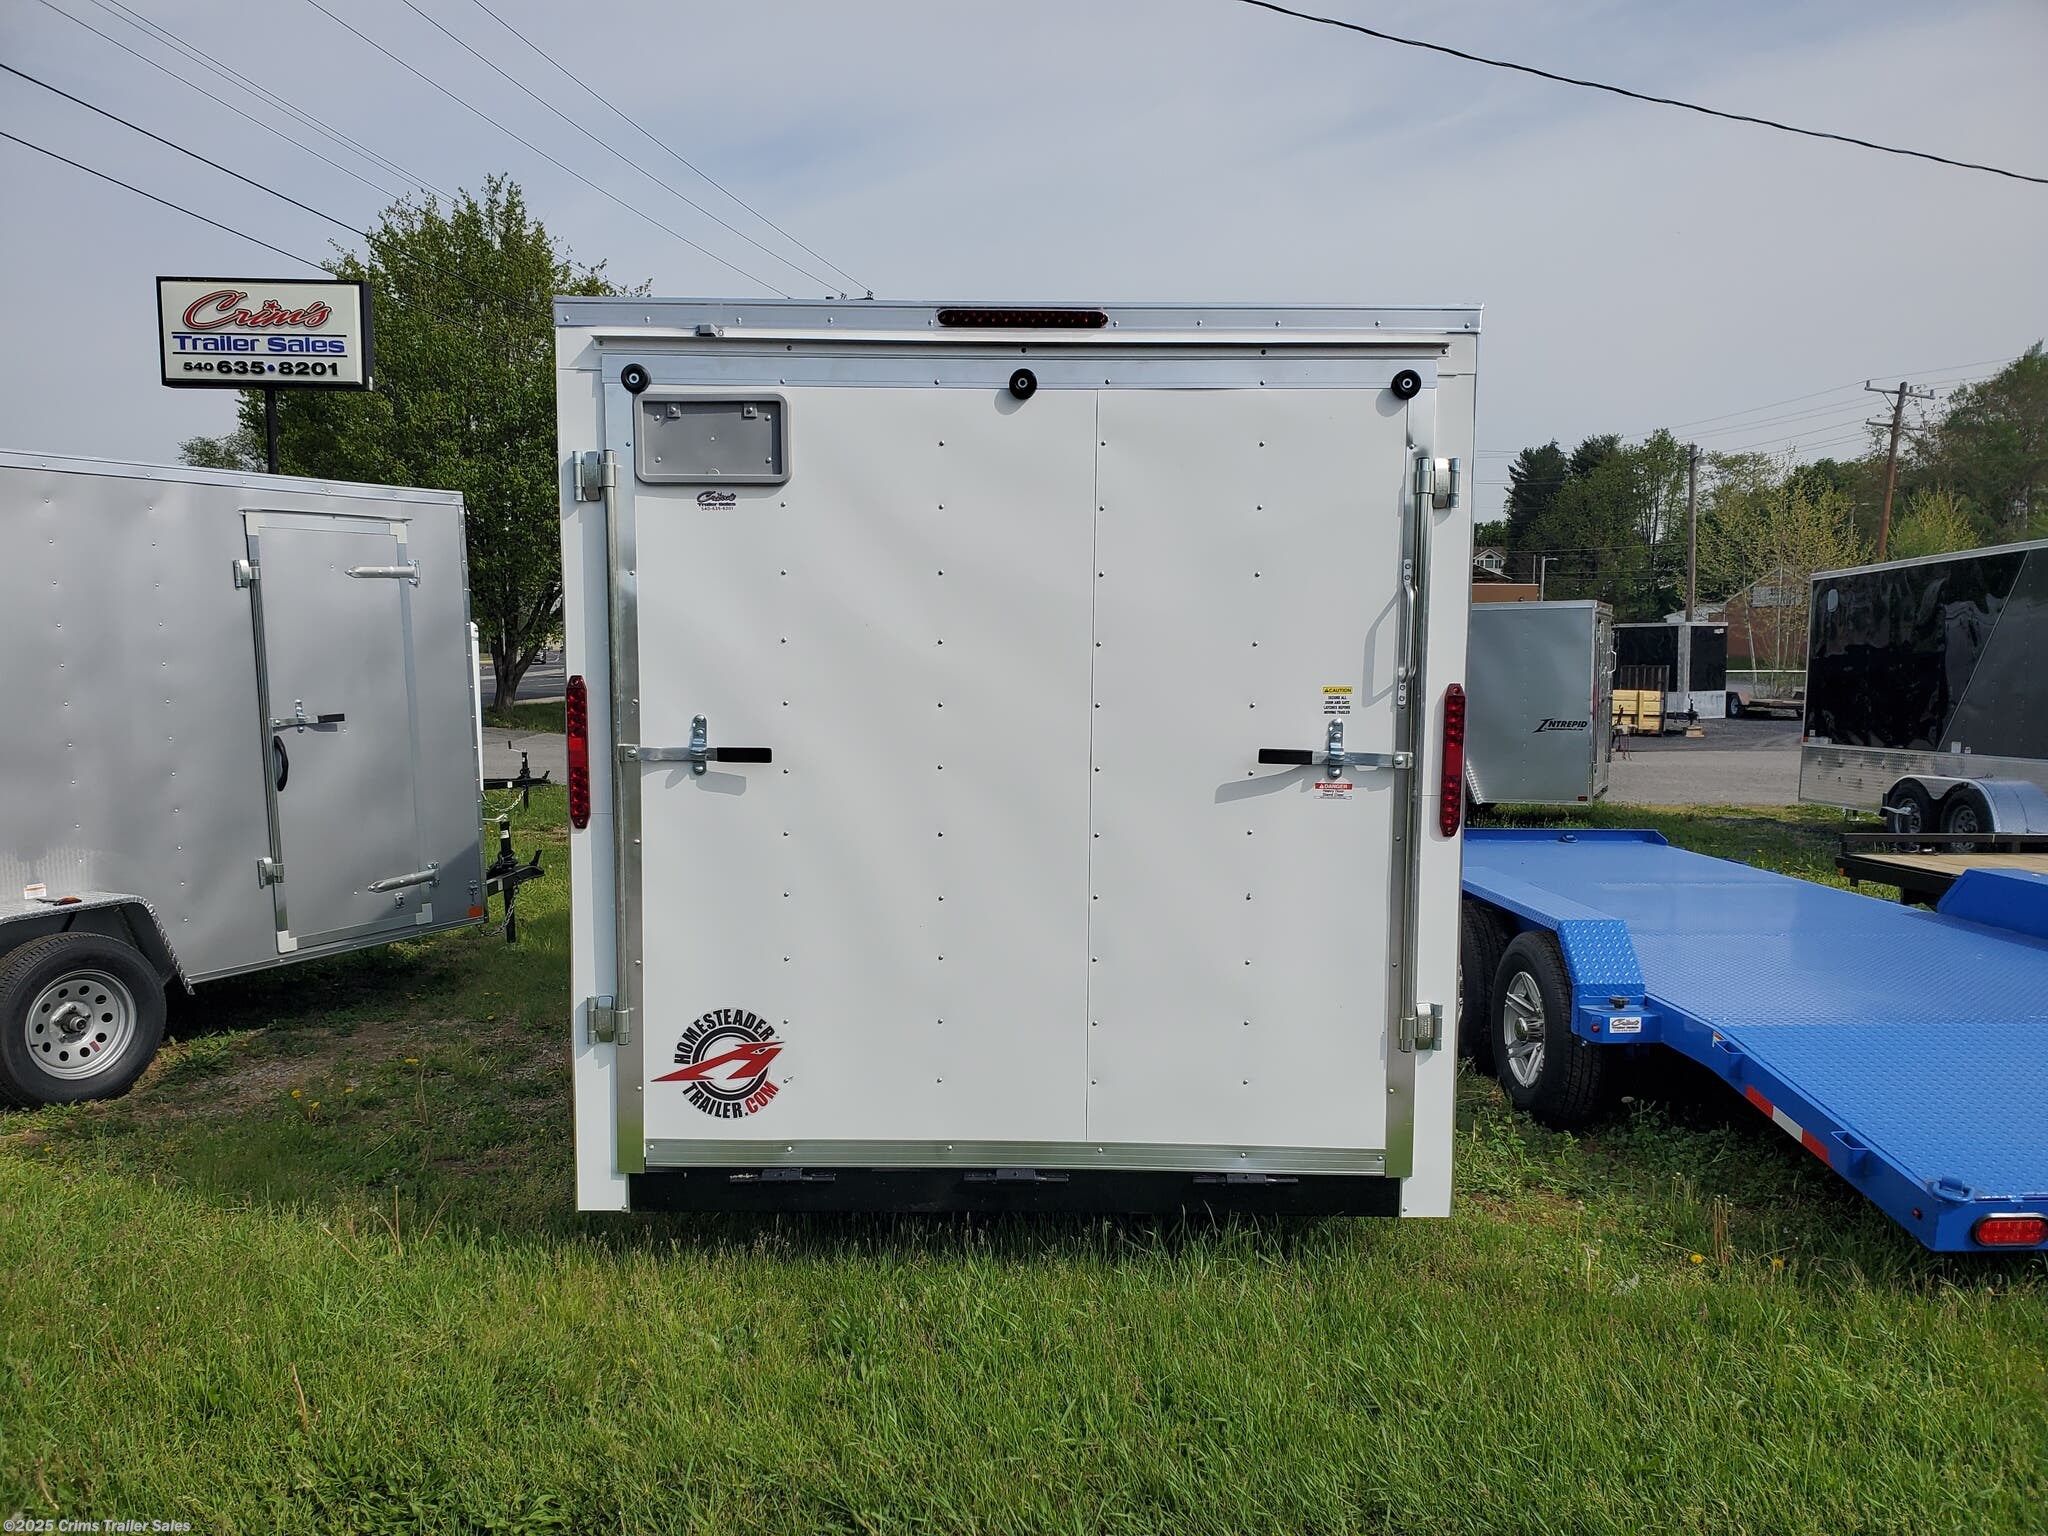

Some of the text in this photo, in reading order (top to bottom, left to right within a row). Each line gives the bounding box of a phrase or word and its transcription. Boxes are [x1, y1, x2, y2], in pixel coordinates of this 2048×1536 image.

[183, 290, 331, 329] Crim's
[173, 335, 345, 353] Trailer Sales
[183, 362, 214, 372] 540
[1532, 718, 1588, 733] INTREPID
[674, 1008, 776, 1064] HOMESTEADER
[682, 1080, 780, 1119] TRAILER.COM
